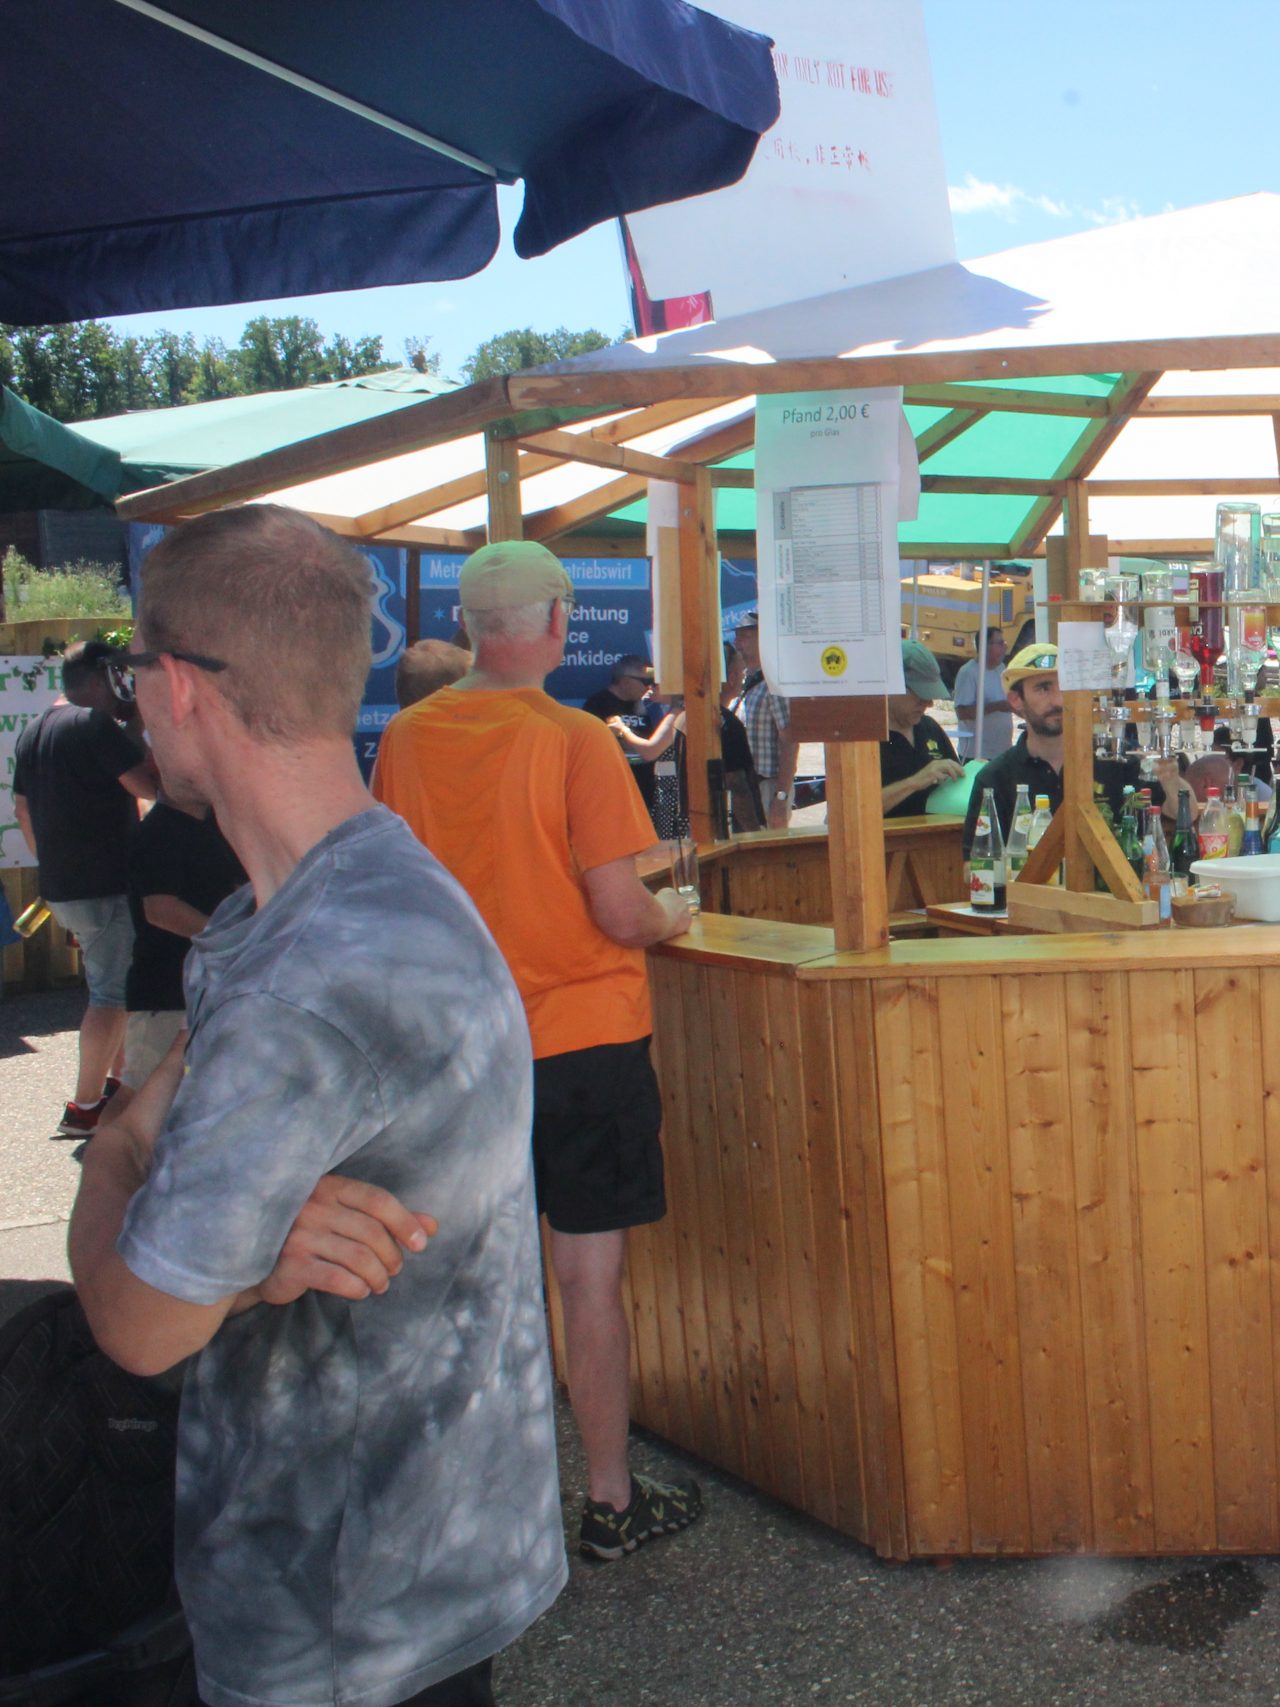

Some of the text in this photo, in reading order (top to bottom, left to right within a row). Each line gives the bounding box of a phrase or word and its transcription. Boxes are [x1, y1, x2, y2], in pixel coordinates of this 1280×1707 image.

[850, 66, 872, 94] FOR
[874, 69, 895, 98] US
[783, 403, 870, 424] Pfand 2,00 €
[569, 606, 629, 624] chtung
[560, 650, 628, 665] enkidee
